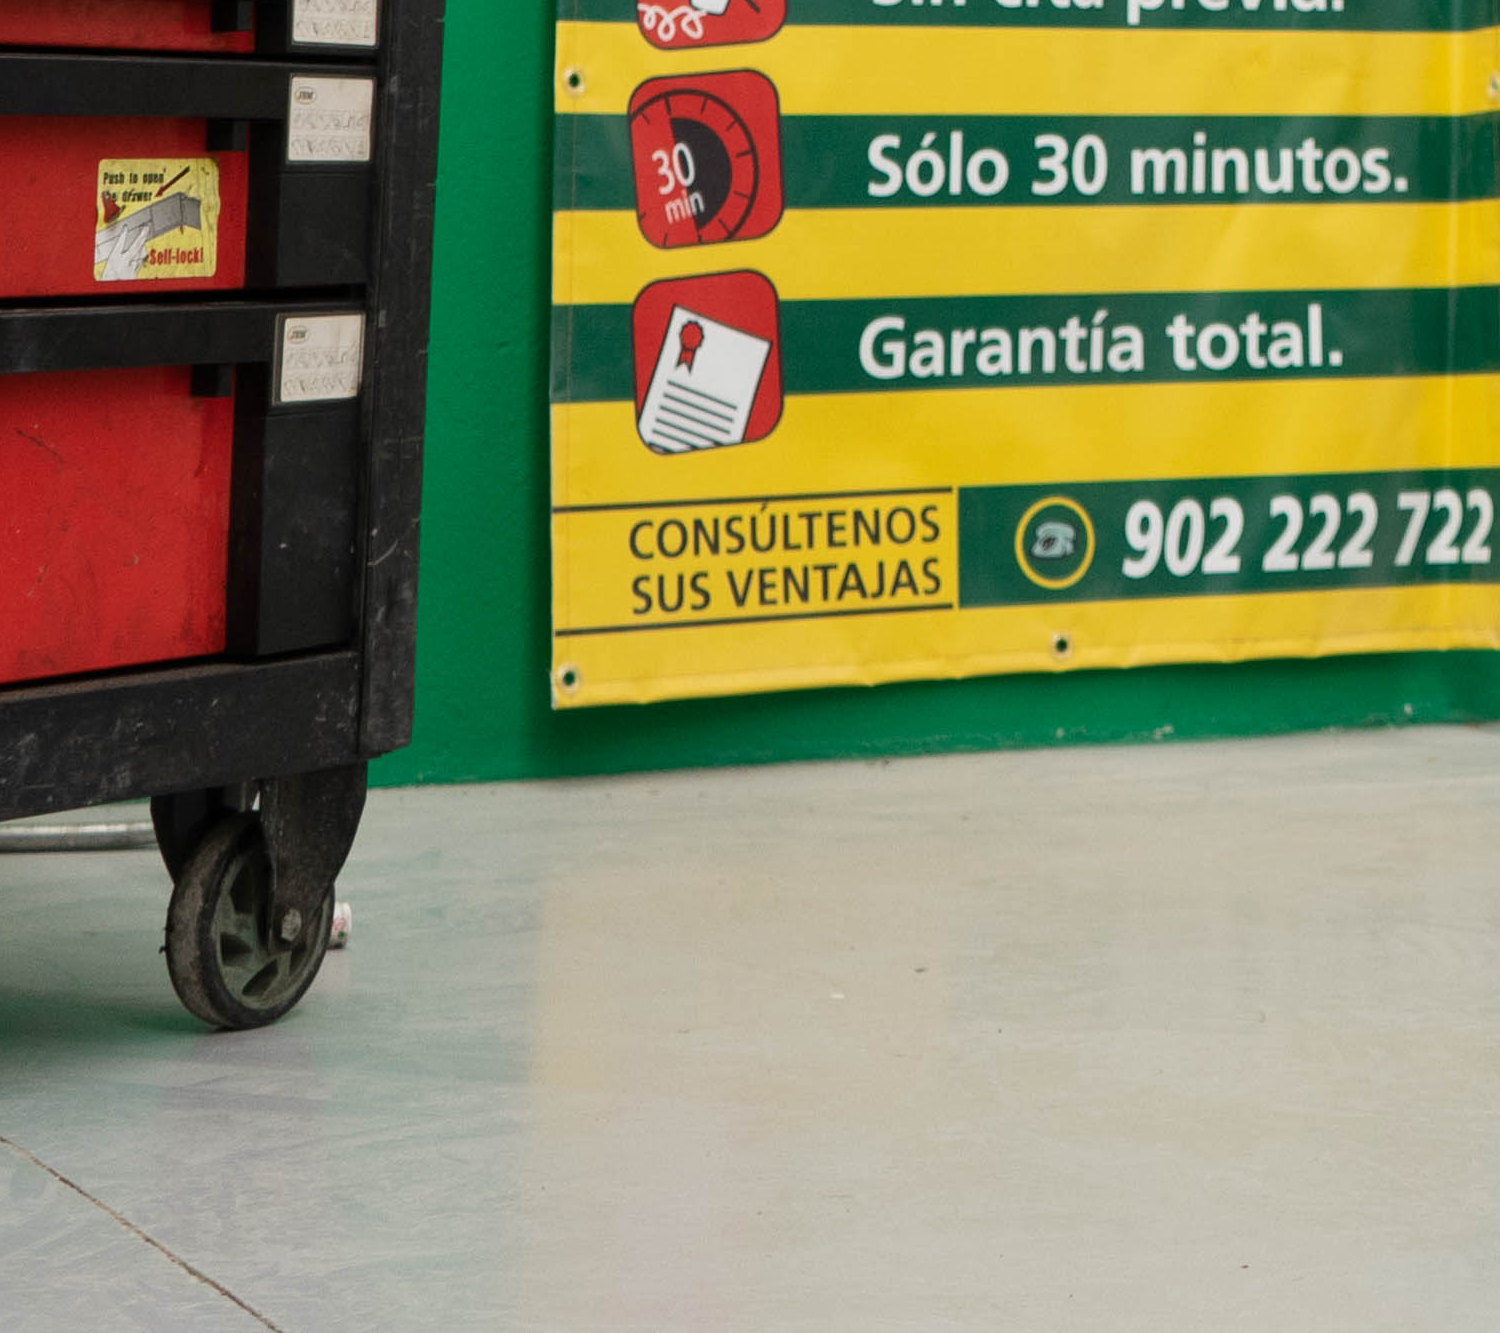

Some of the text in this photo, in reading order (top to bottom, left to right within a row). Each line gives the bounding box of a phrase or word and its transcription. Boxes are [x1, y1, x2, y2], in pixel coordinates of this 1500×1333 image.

[103, 172, 164, 184] Push to open
[651, 143, 697, 196] 30
[866, 132, 1409, 197] Sólo 30 minutos.
[664, 189, 705, 225] min
[858, 305, 1344, 379] Garantía total.
[627, 502, 940, 561] CONSÚLTENOS
[1121, 488, 1494, 580] 902 222 722
[631, 557, 943, 616] SUS VENTAJAS
